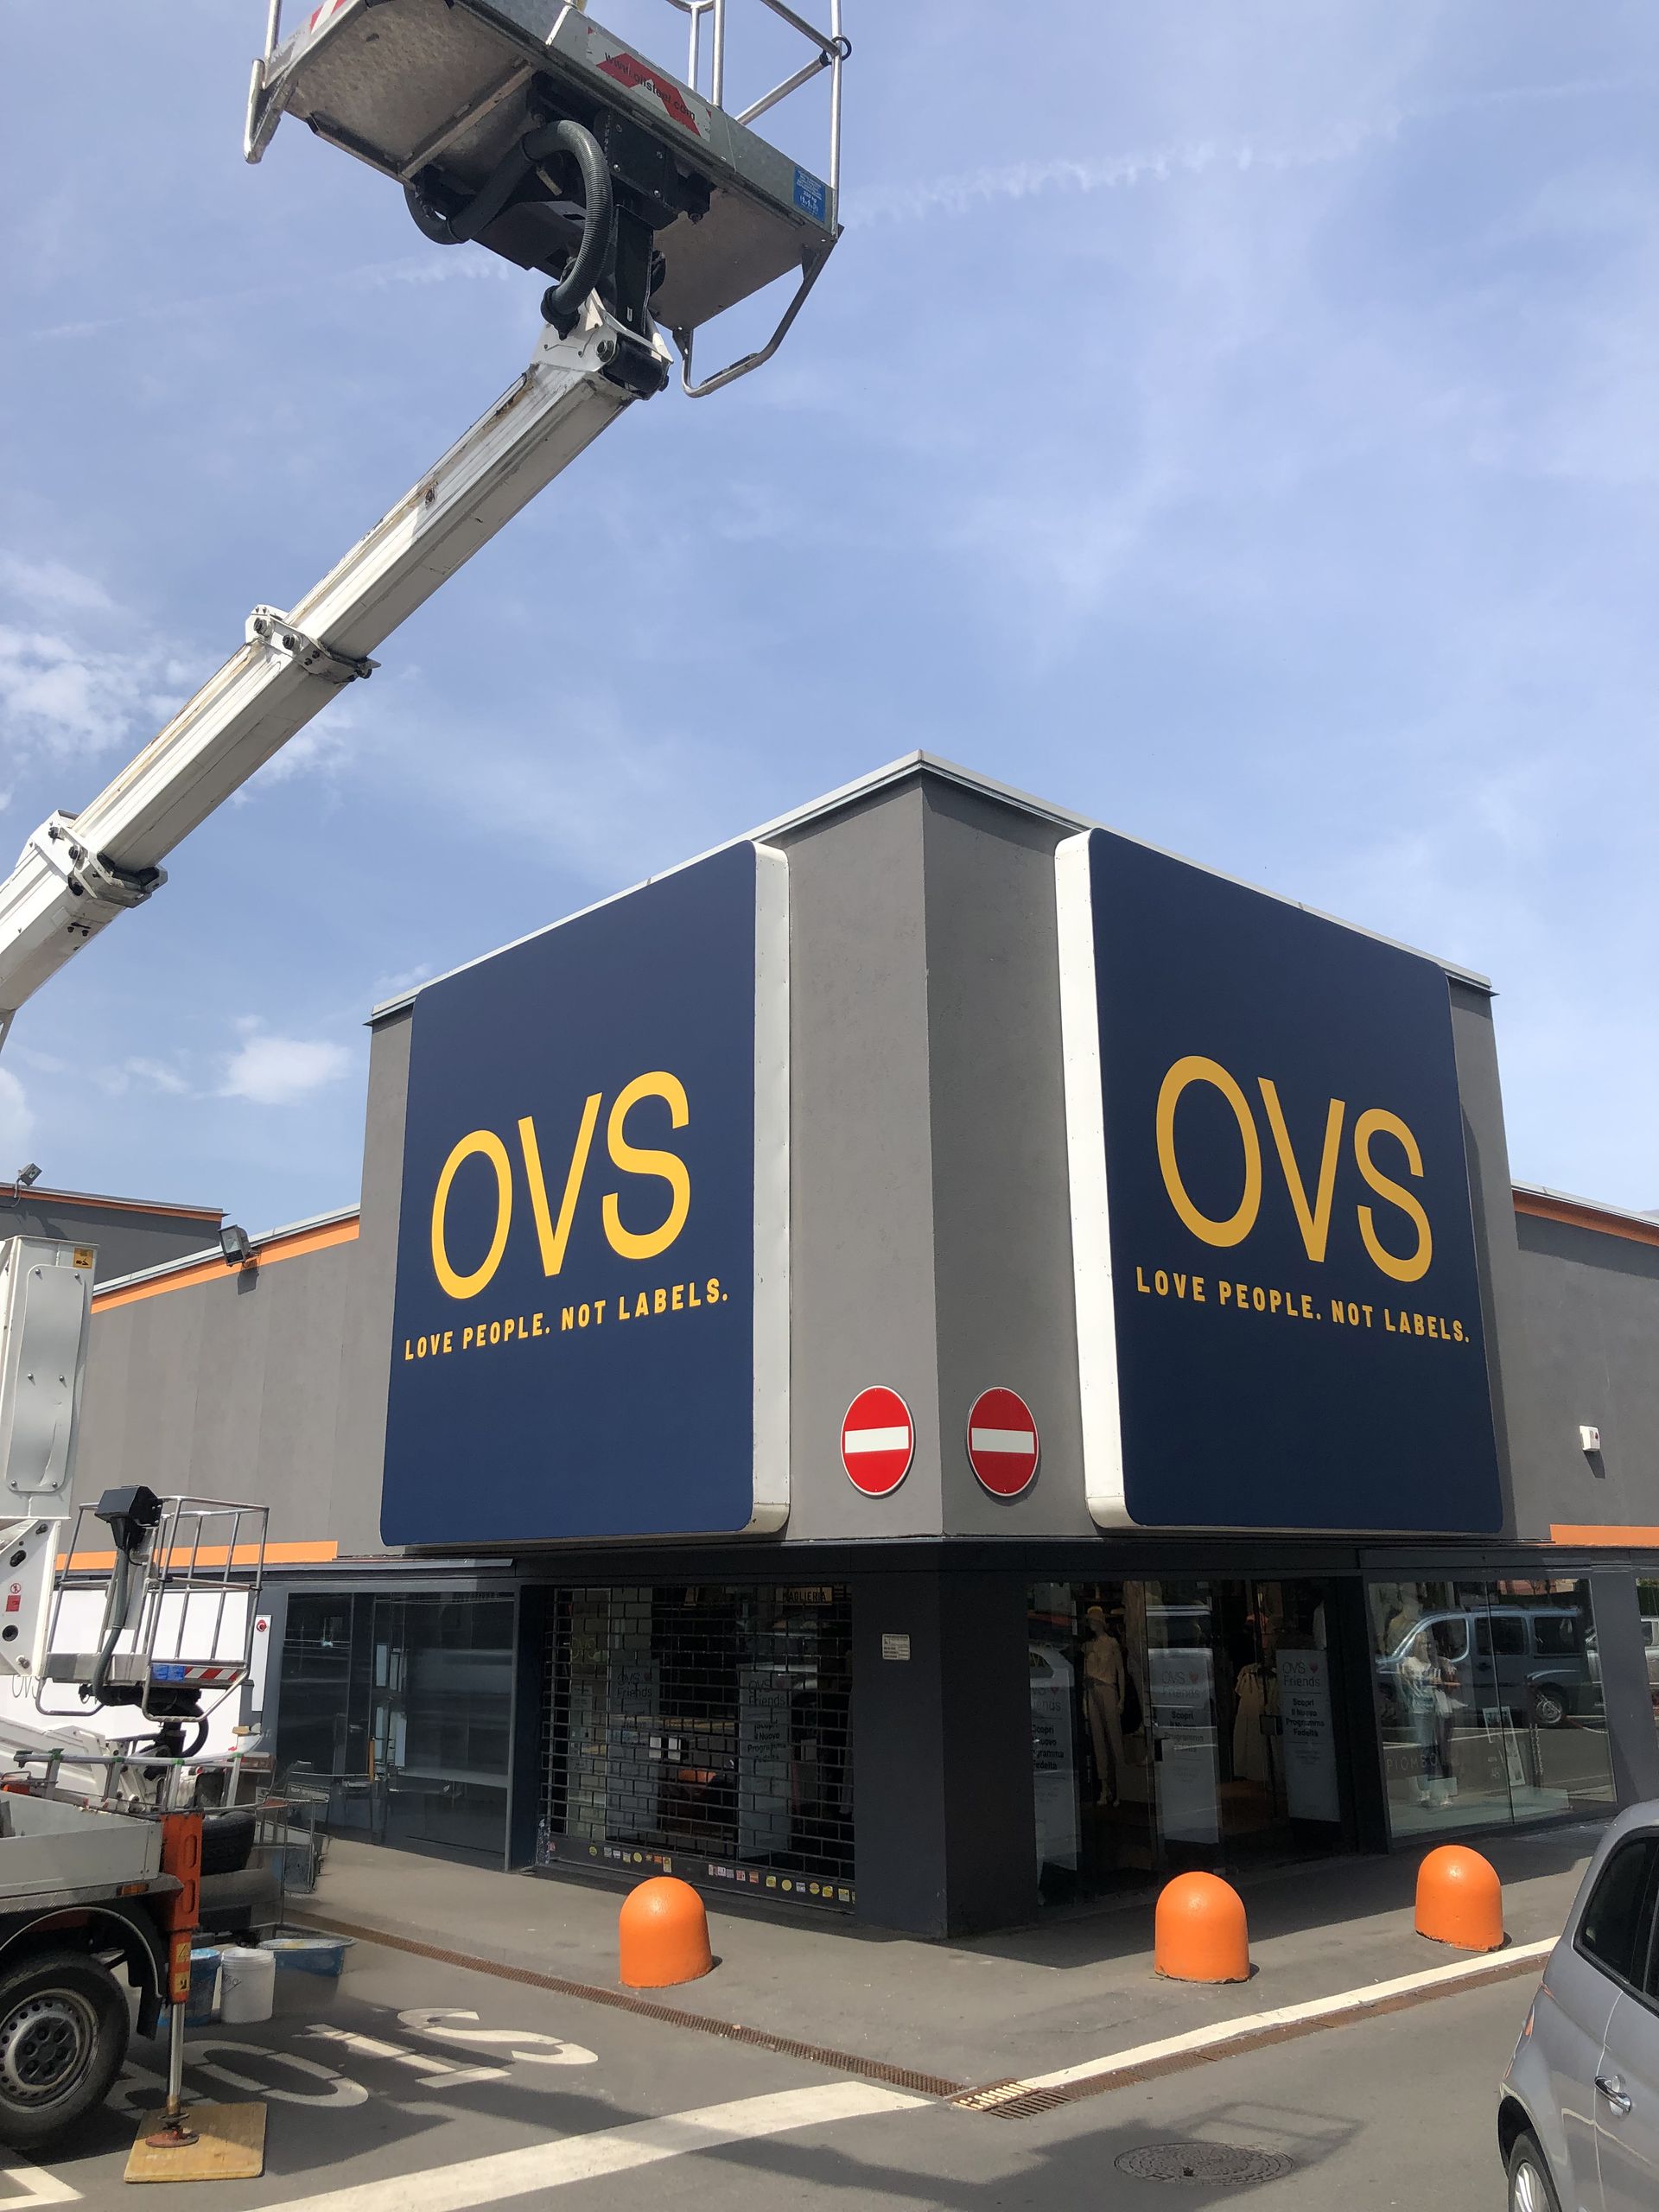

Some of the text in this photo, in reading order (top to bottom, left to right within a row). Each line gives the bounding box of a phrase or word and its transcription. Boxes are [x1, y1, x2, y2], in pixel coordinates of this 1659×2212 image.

[1155, 1055, 1433, 1282] OVS
[430, 1071, 691, 1300] OVS
[1135, 1266, 1471, 1344] LOVE PEOPLE. NOT LABELS.
[404, 1277, 729, 1361] LOVE PEOPLE. NOT LABELS.
[784, 1590, 826, 1602] AGLIERA
[1282, 1661, 1306, 1675] OVS
[1283, 1675, 1321, 1688] Friends
[616, 1686, 652, 1700] Friends
[749, 1694, 786, 1707] Friends
[1033, 1698, 1062, 1712] iends
[1292, 1698, 1314, 1707] Scopri
[1386, 1752, 1438, 1774] PIOMBO
